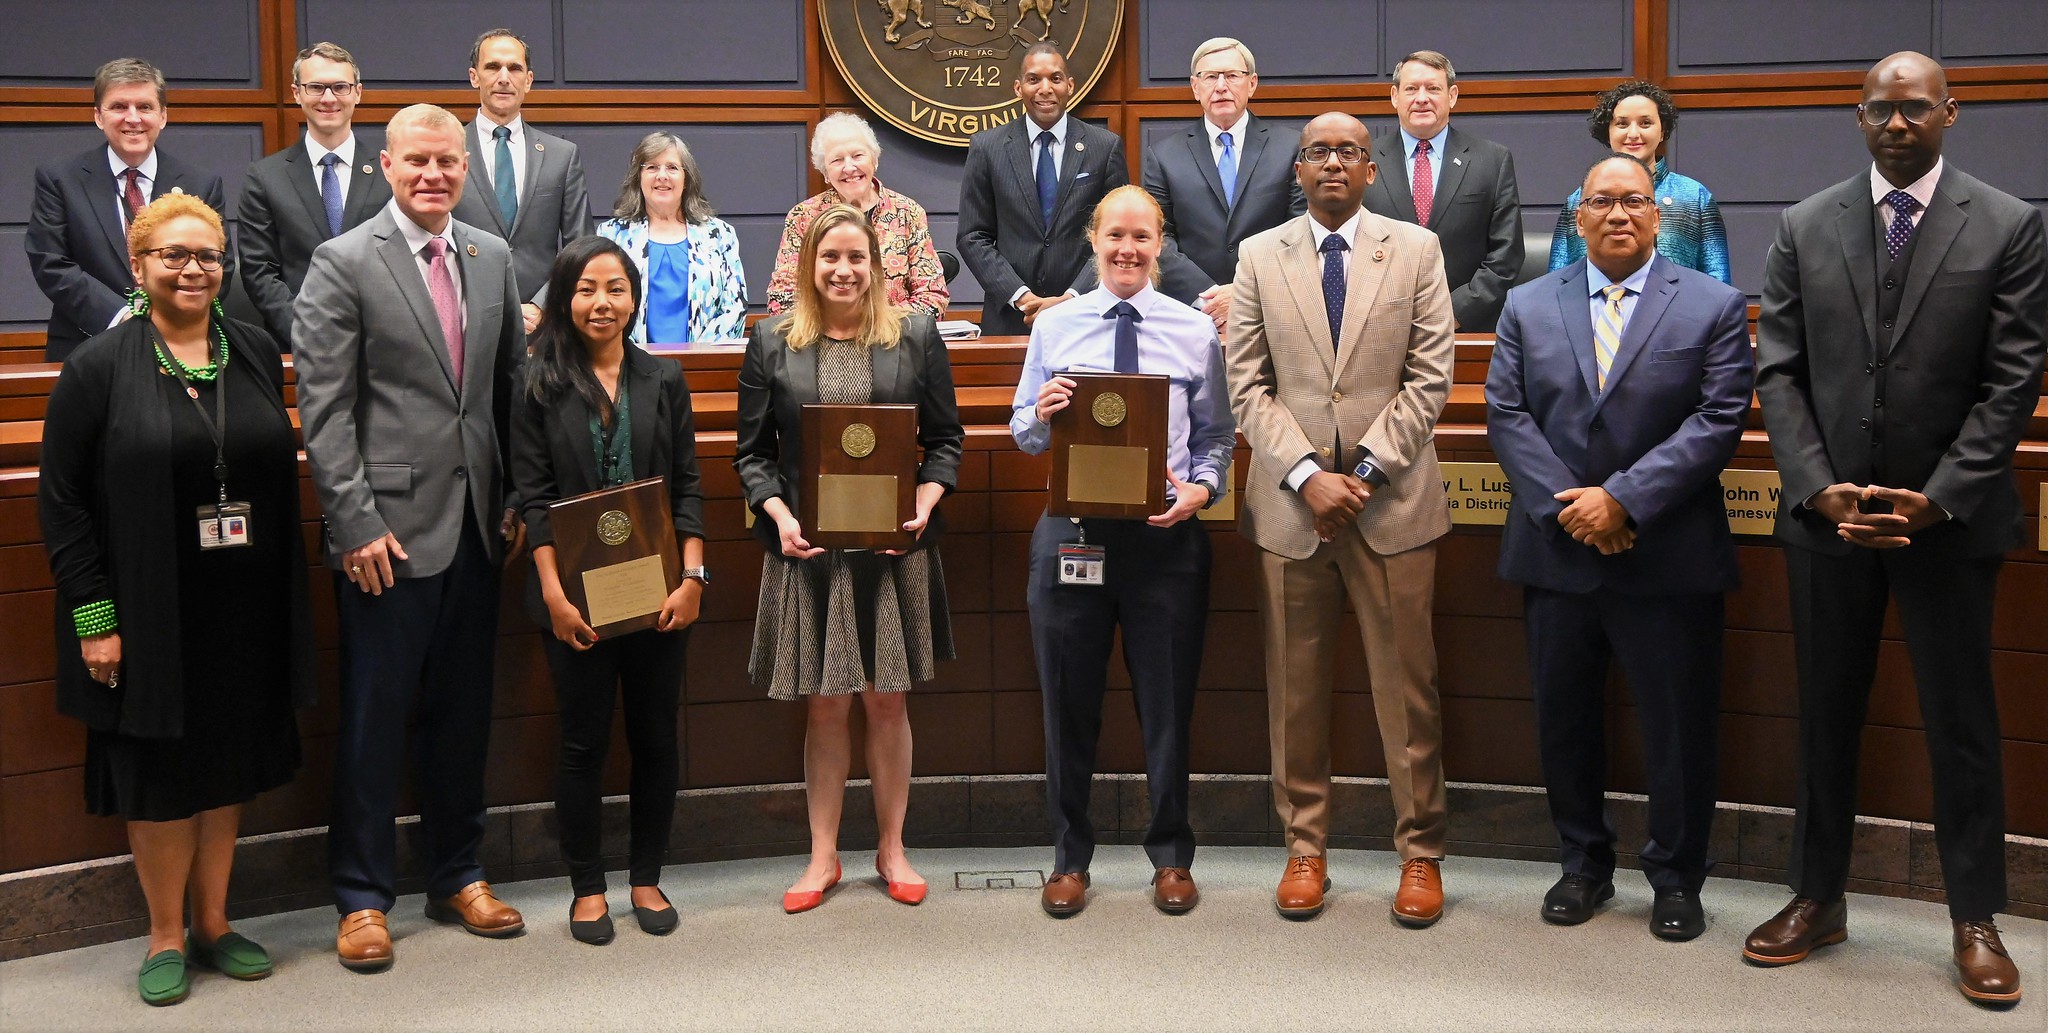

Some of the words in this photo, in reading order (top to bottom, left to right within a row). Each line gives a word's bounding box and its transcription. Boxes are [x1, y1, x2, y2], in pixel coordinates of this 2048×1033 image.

[948, 49, 969, 57] FARE
[944, 64, 1000, 87] 1742
[1459, 477, 1473, 492] L.
[1725, 508, 1776, 519] anesvi
